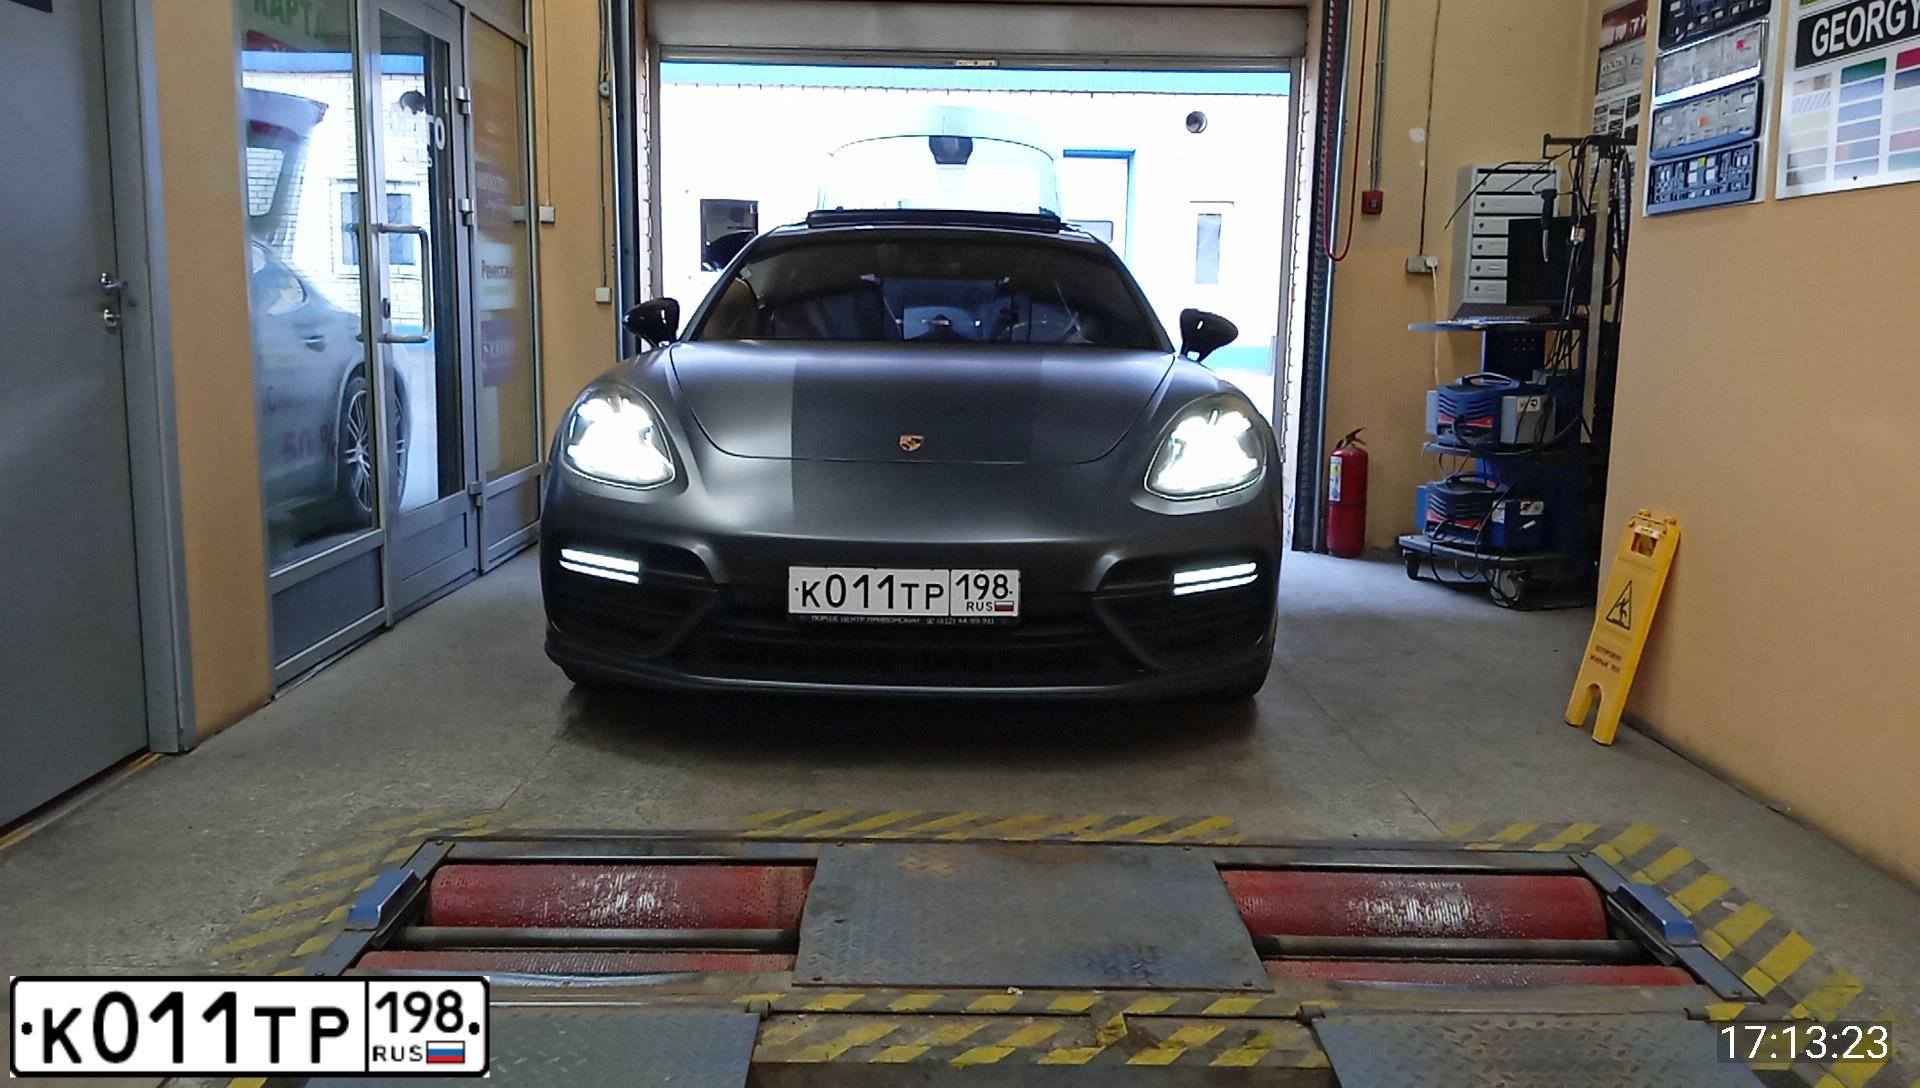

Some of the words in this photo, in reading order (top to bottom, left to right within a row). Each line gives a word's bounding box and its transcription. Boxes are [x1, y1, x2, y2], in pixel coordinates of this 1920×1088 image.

[802, 574, 944, 610] К011ТР
[955, 573, 1009, 600] 198
[966, 601, 993, 612] RUS
